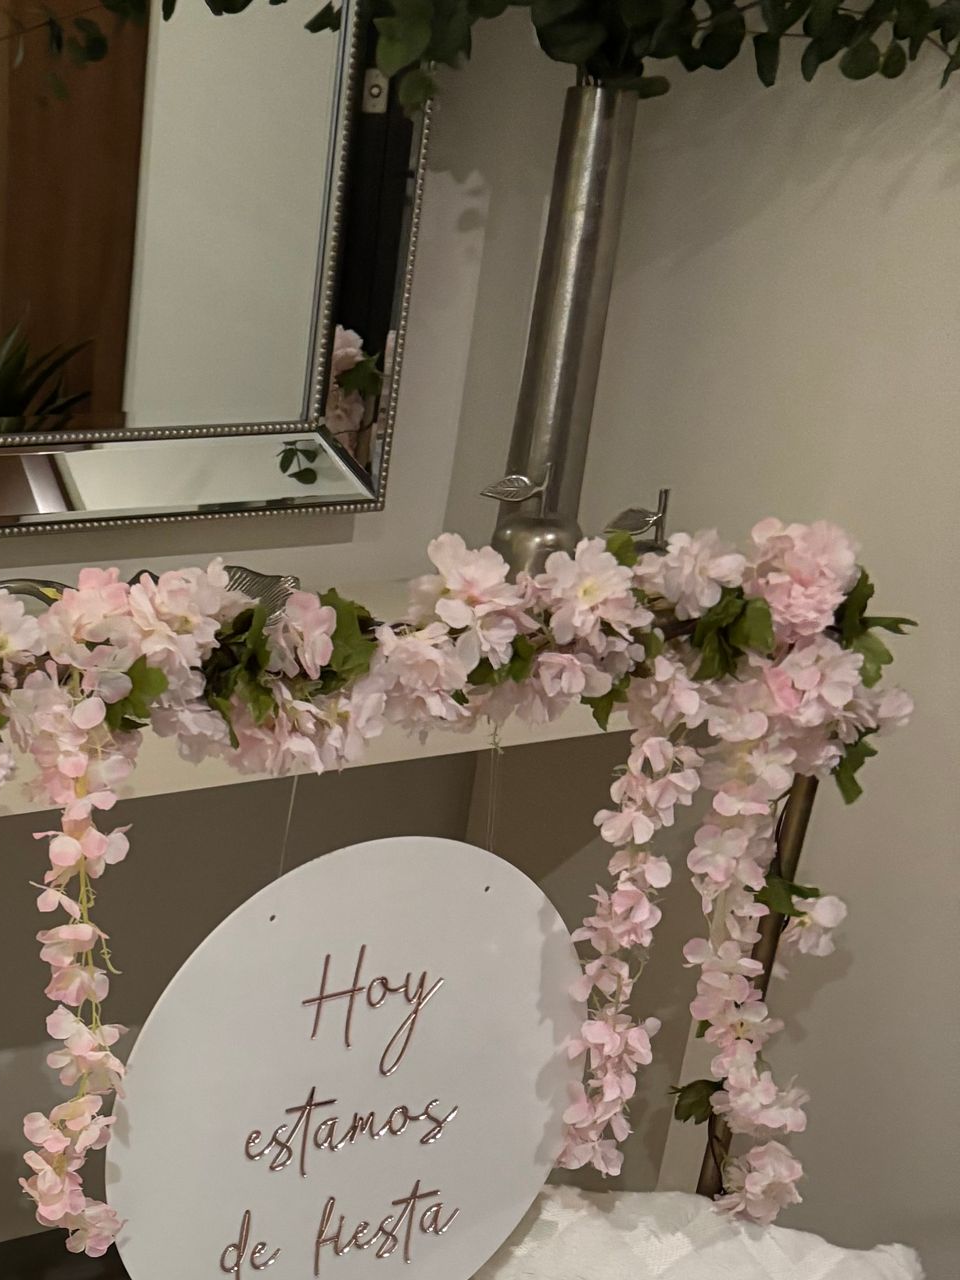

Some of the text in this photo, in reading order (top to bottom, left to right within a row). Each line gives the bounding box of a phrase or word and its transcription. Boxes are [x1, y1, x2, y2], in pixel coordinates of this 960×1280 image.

[302, 944, 445, 1076] Hoy
[244, 1086, 459, 1178] estamos
[313, 1179, 460, 1278] fiesta
